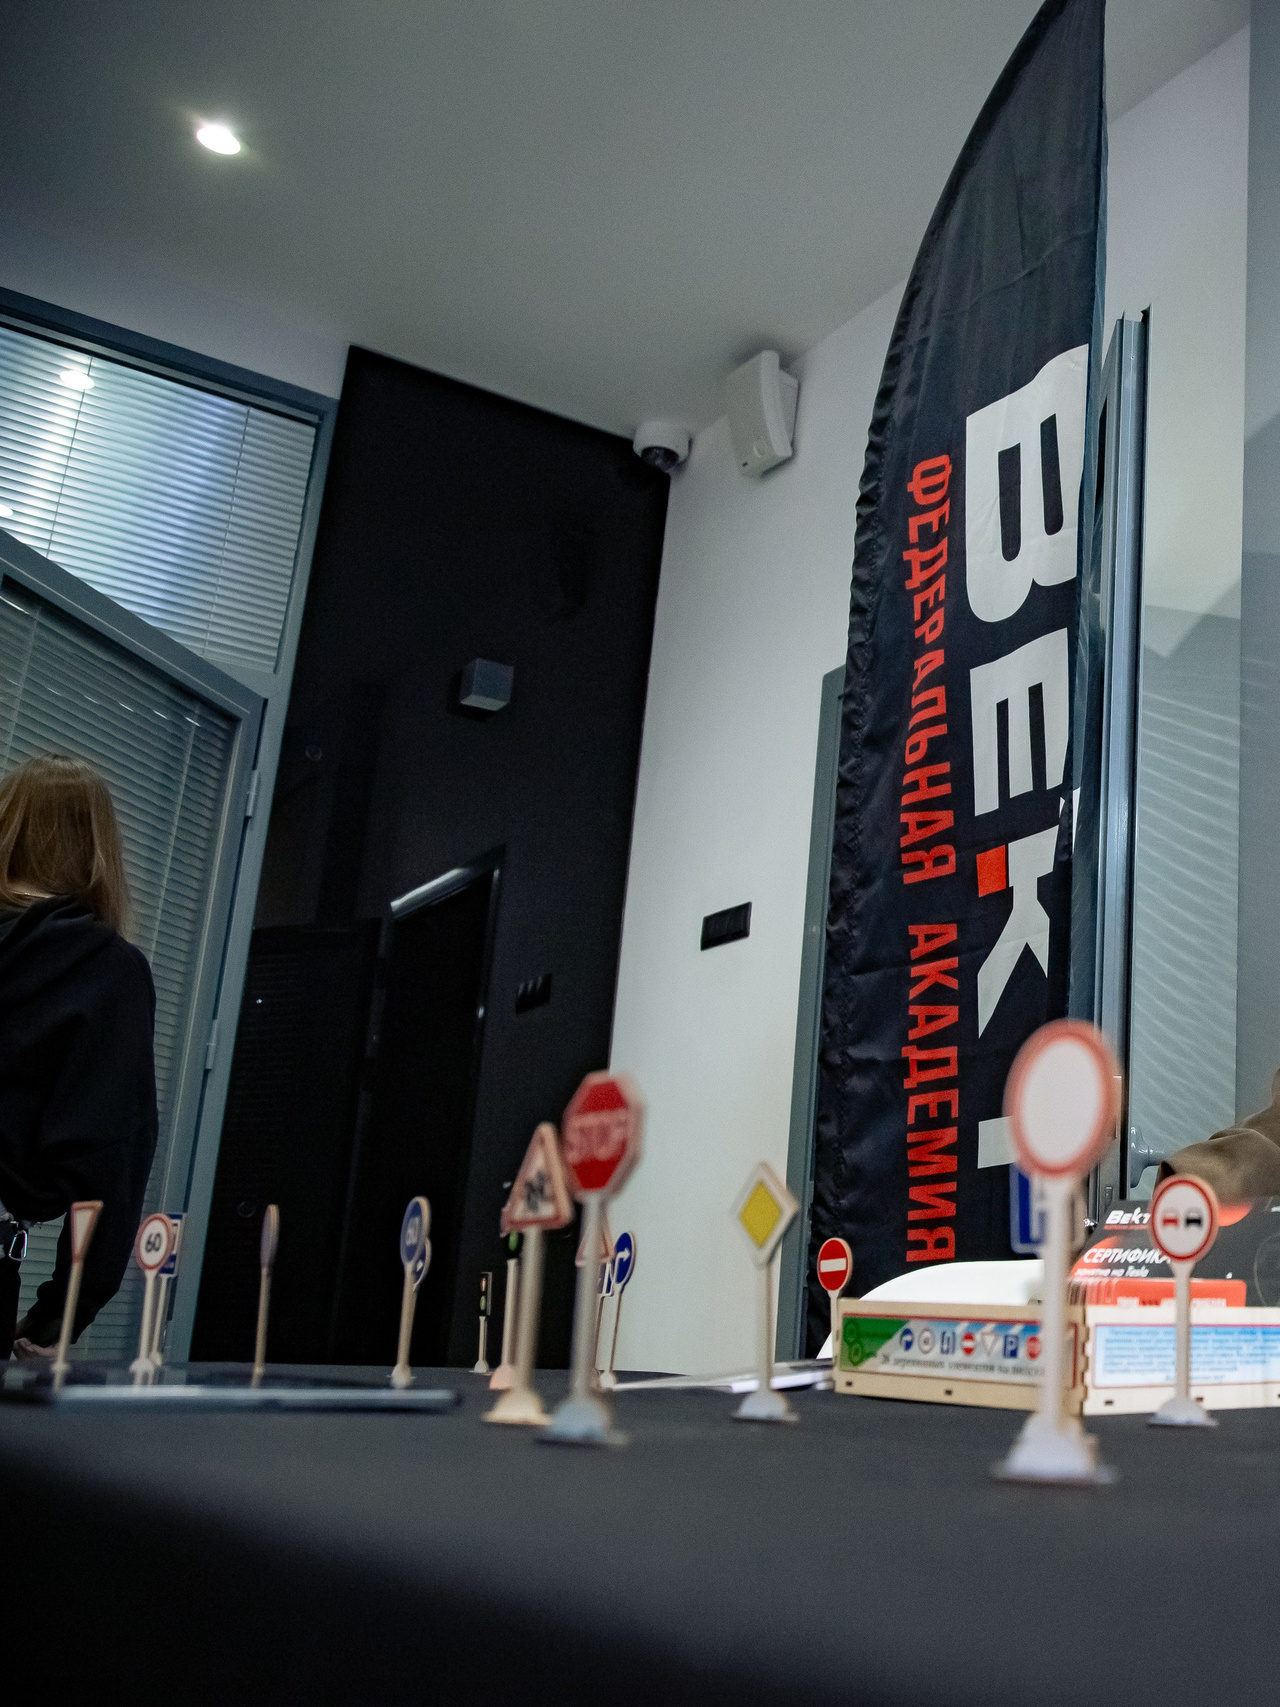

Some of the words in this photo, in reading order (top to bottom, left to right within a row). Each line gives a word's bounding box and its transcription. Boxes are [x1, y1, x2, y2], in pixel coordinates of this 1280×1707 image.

[899, 454, 957, 885] ФЕДЕРАЛЬНАЯ
[145, 1233, 162, 1253] 60
[903, 923, 959, 1263] АКАДЕМИЯ
